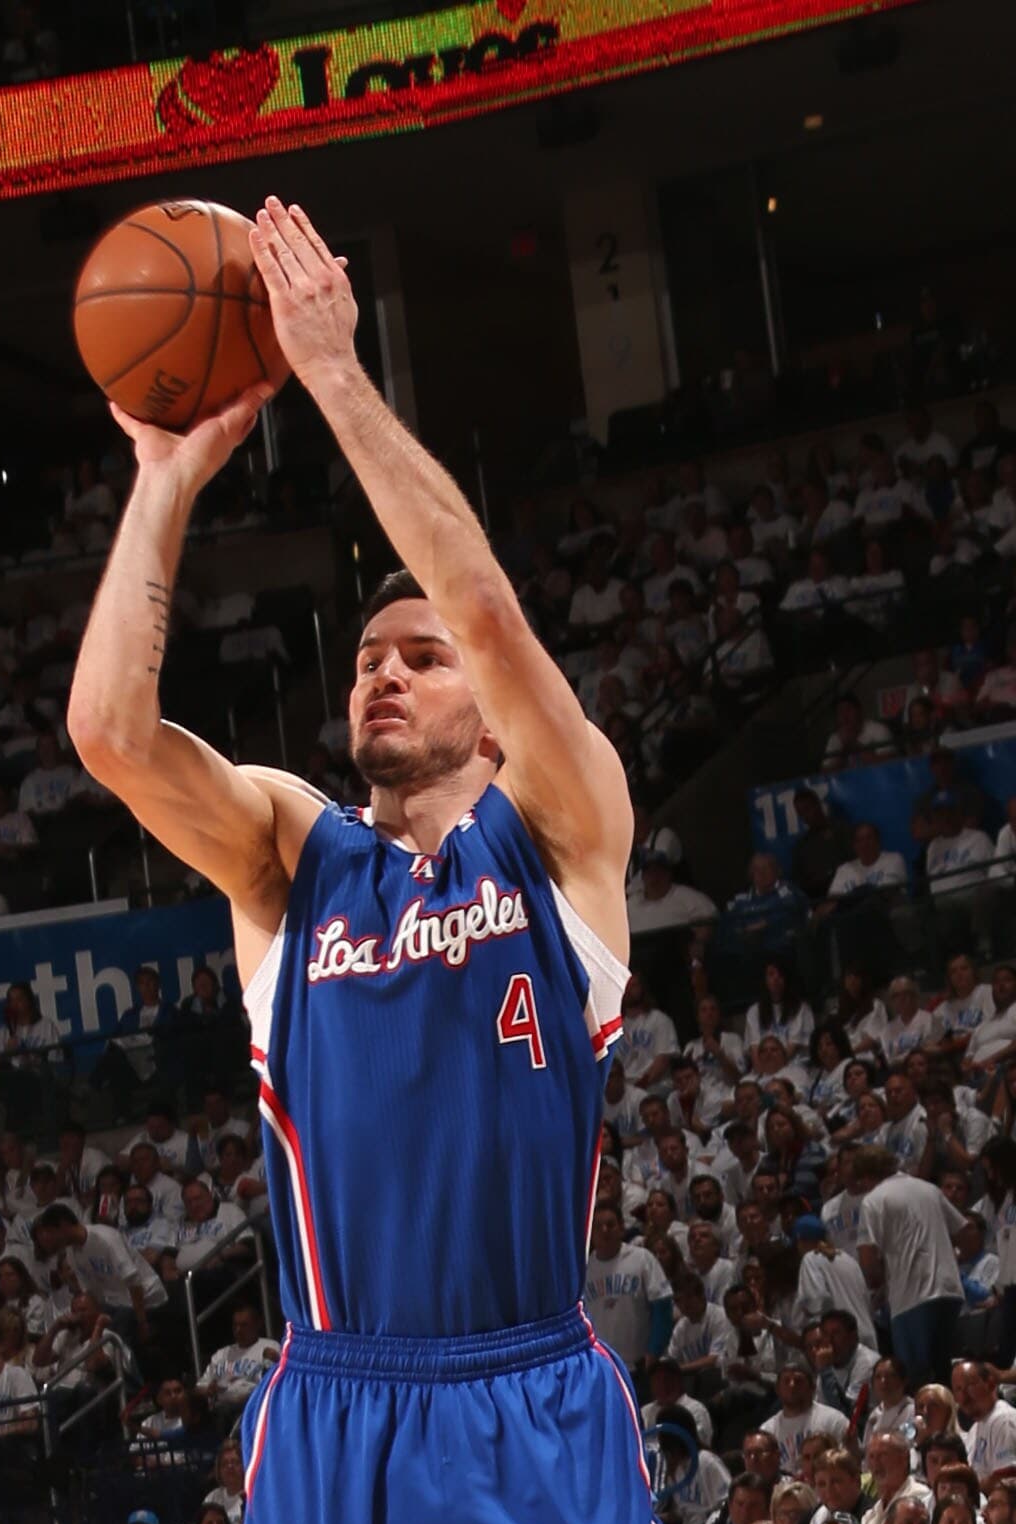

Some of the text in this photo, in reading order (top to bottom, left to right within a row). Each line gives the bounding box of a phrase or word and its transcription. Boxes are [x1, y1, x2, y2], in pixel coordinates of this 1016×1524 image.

[308, 877, 529, 984] Los Angeles
[497, 973, 547, 1069] 4
